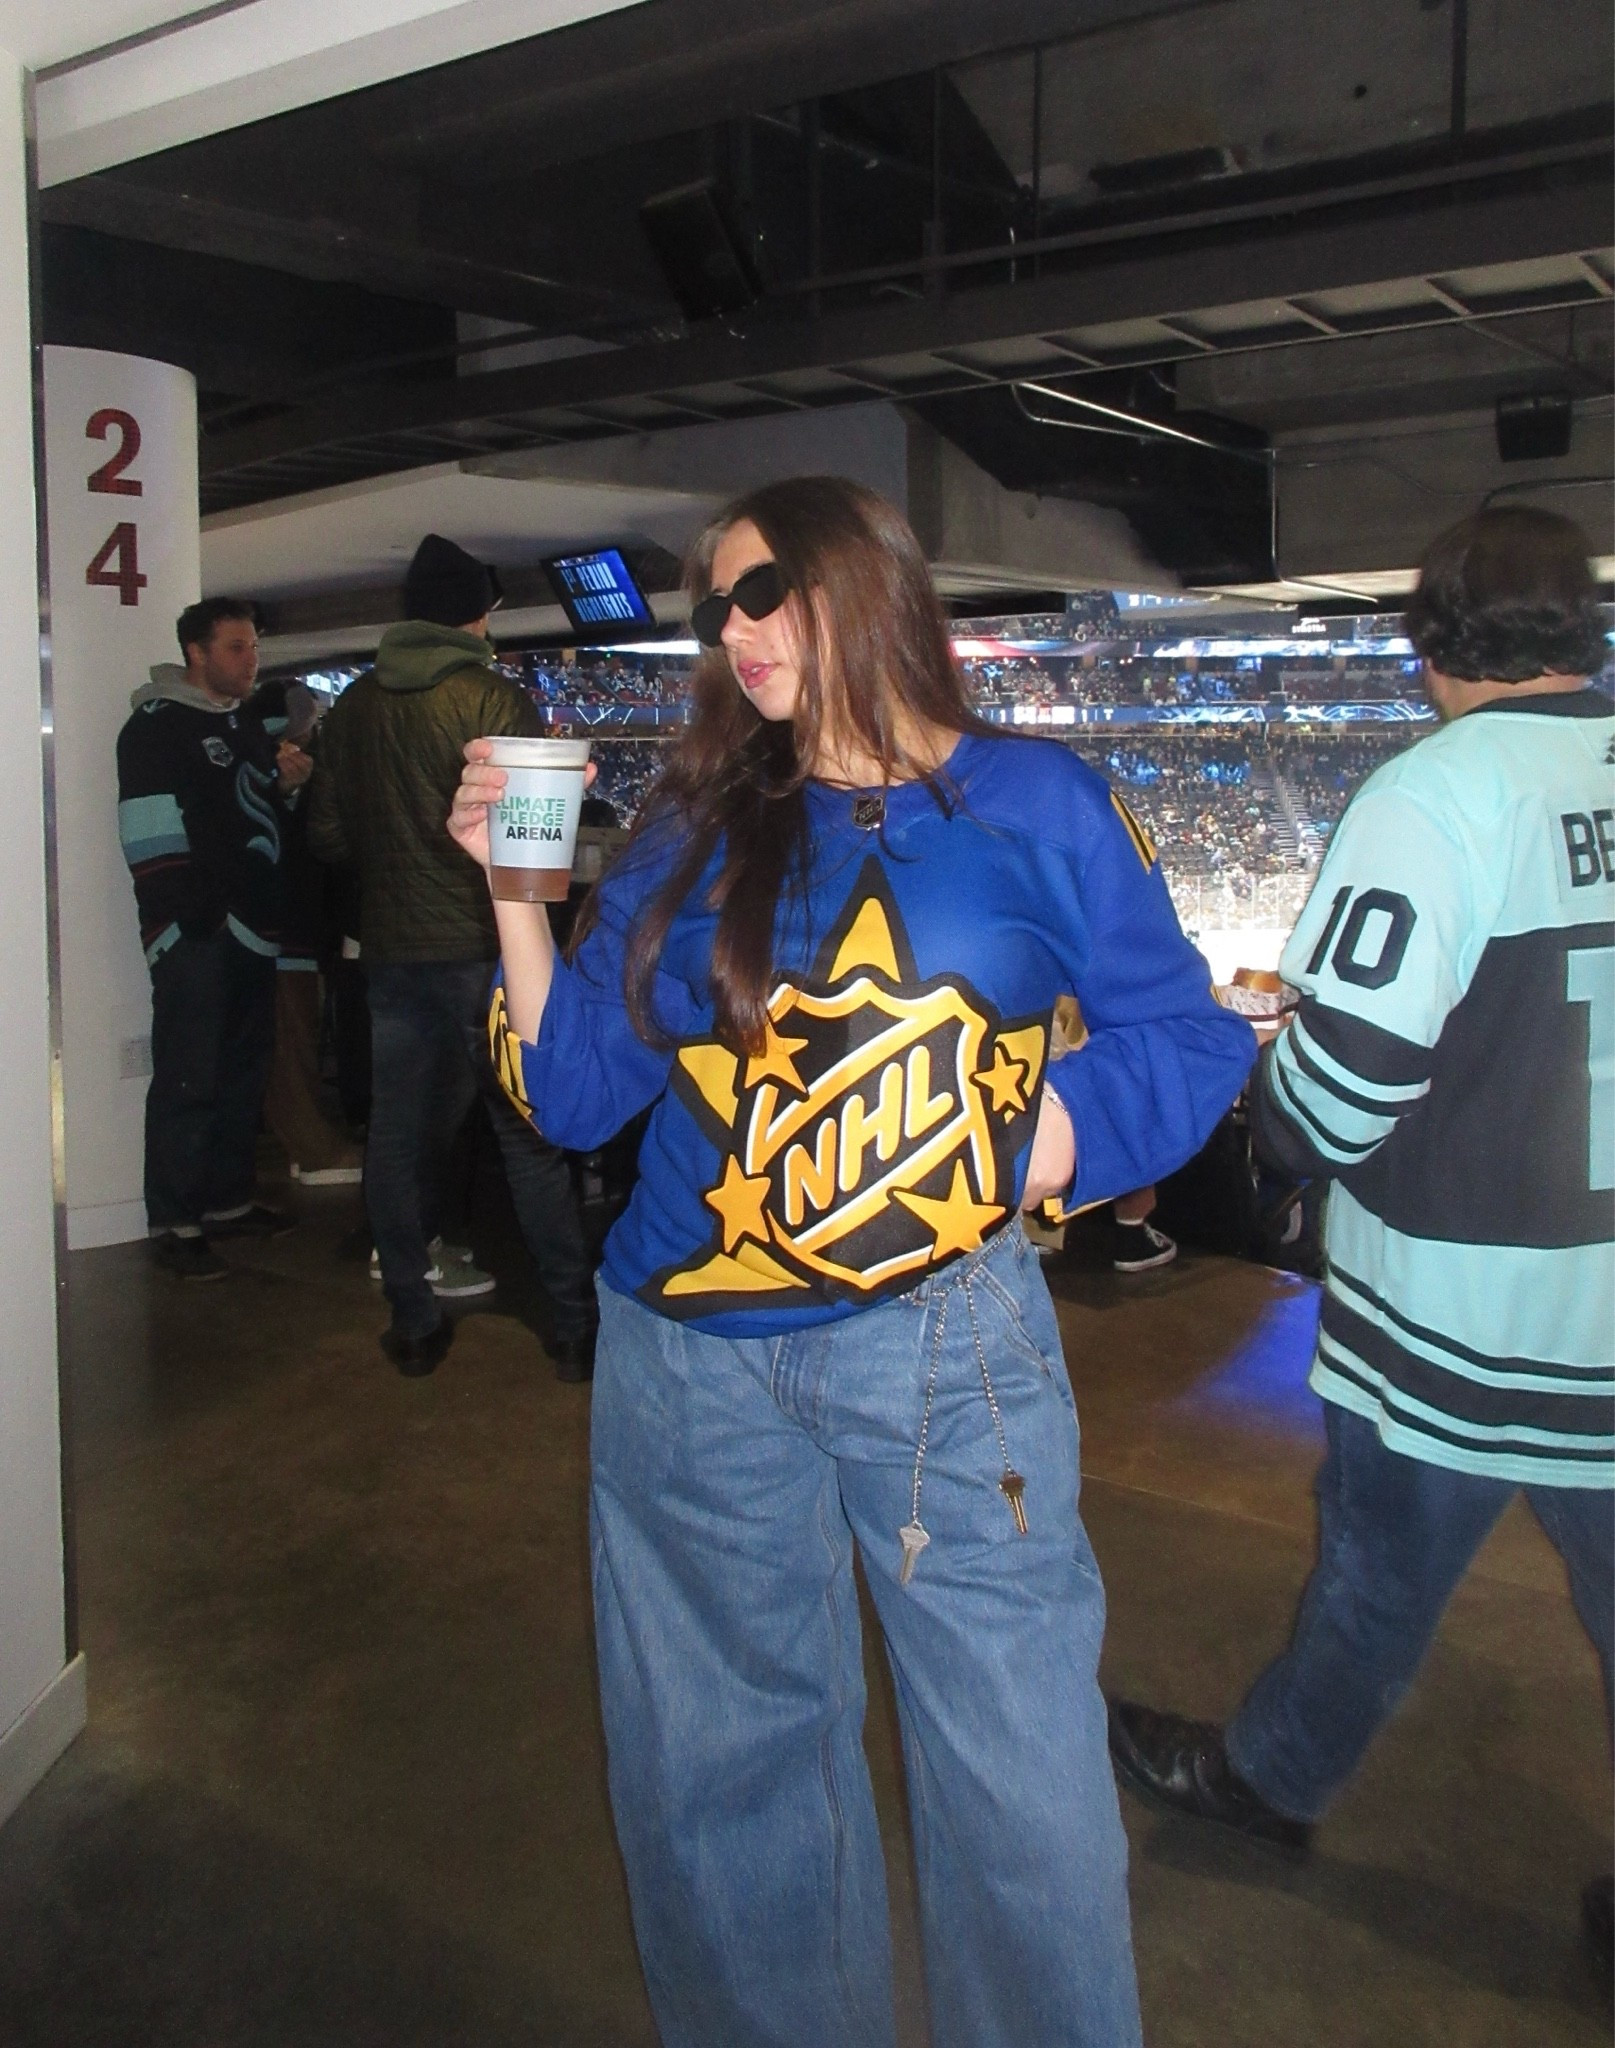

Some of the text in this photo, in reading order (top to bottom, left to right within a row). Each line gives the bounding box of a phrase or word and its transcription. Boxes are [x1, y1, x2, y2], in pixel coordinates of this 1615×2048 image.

[86, 408, 148, 606] 24
[500, 810, 564, 827] PLEDGE
[506, 825, 563, 841] ARENA
[1306, 886, 1418, 991] 10
[785, 1045, 954, 1225] NHL
